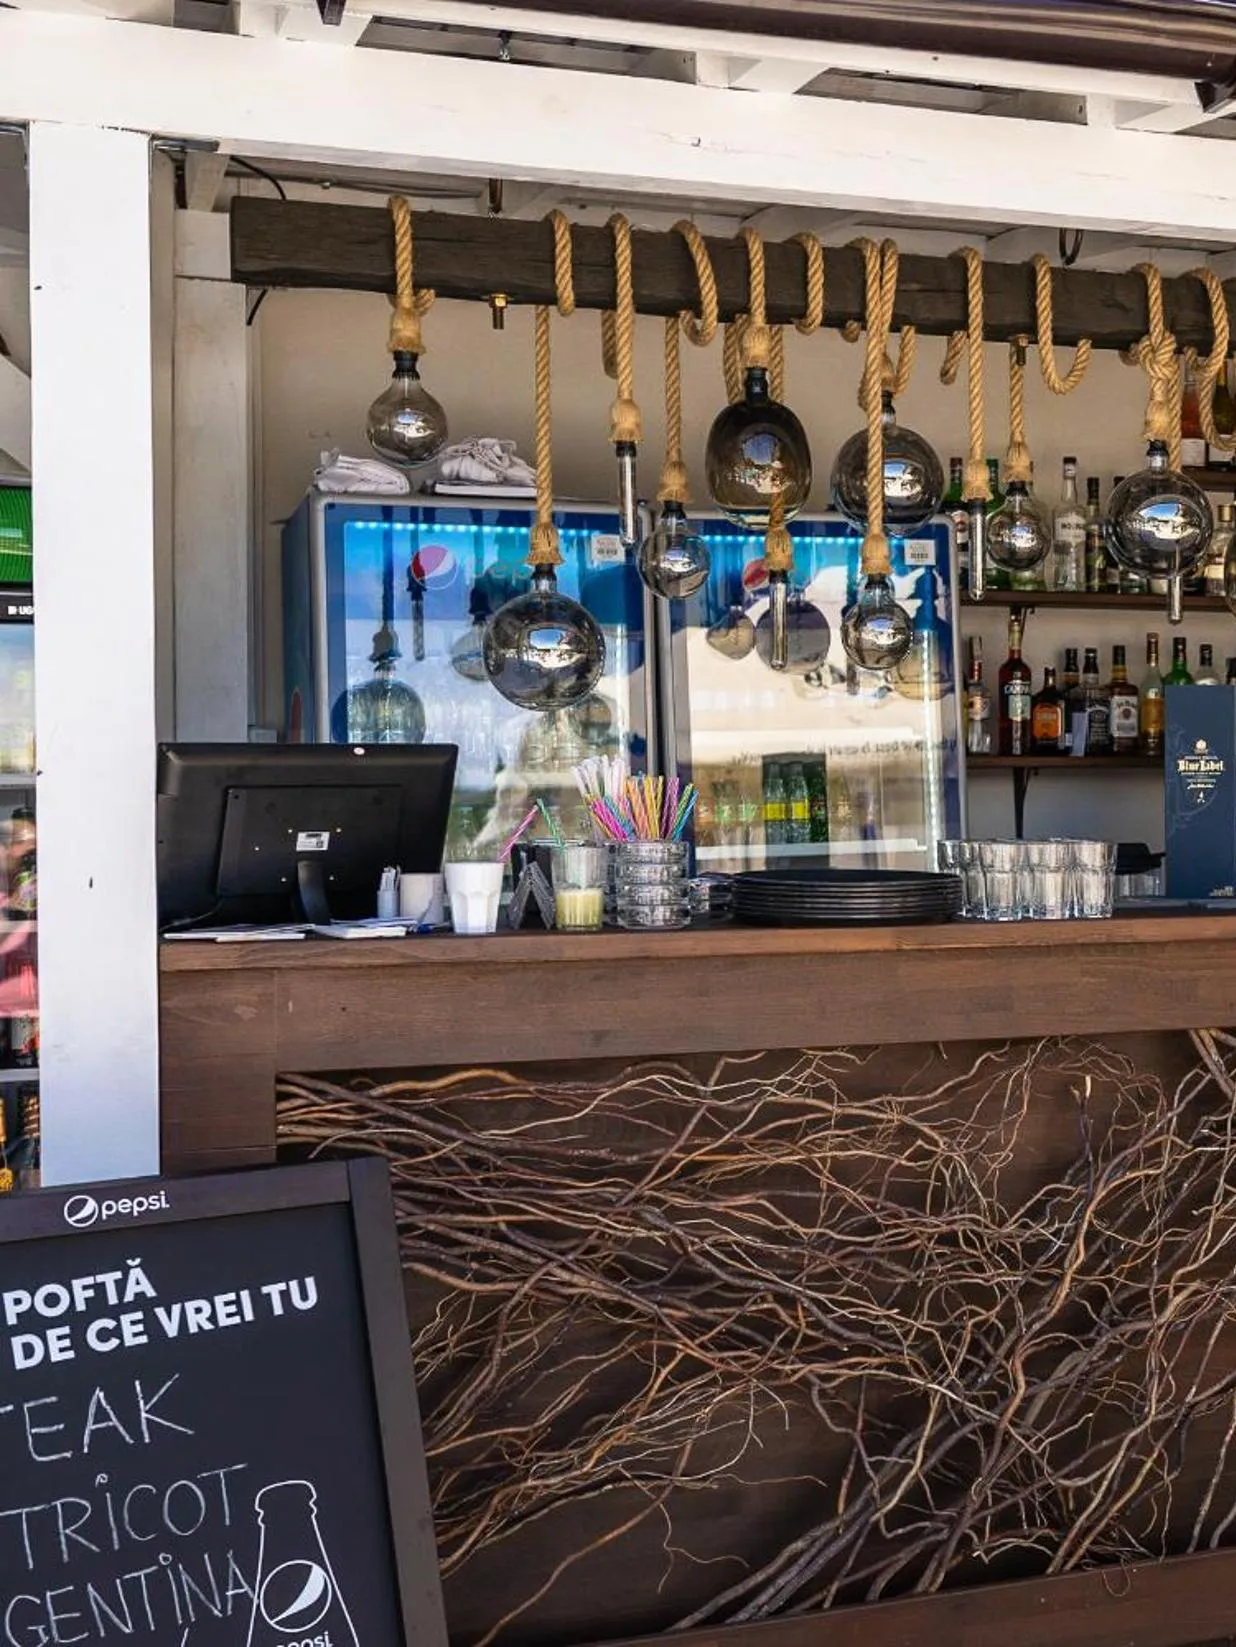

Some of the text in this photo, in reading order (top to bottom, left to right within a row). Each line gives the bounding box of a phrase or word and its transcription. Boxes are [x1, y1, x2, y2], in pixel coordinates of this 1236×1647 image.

[102, 1190, 167, 1220] pepsi
[3, 1257, 158, 1325] POFTĂ
[11, 1276, 319, 1370] DE CE VREI TU
[0, 1373, 194, 1461] EAK
